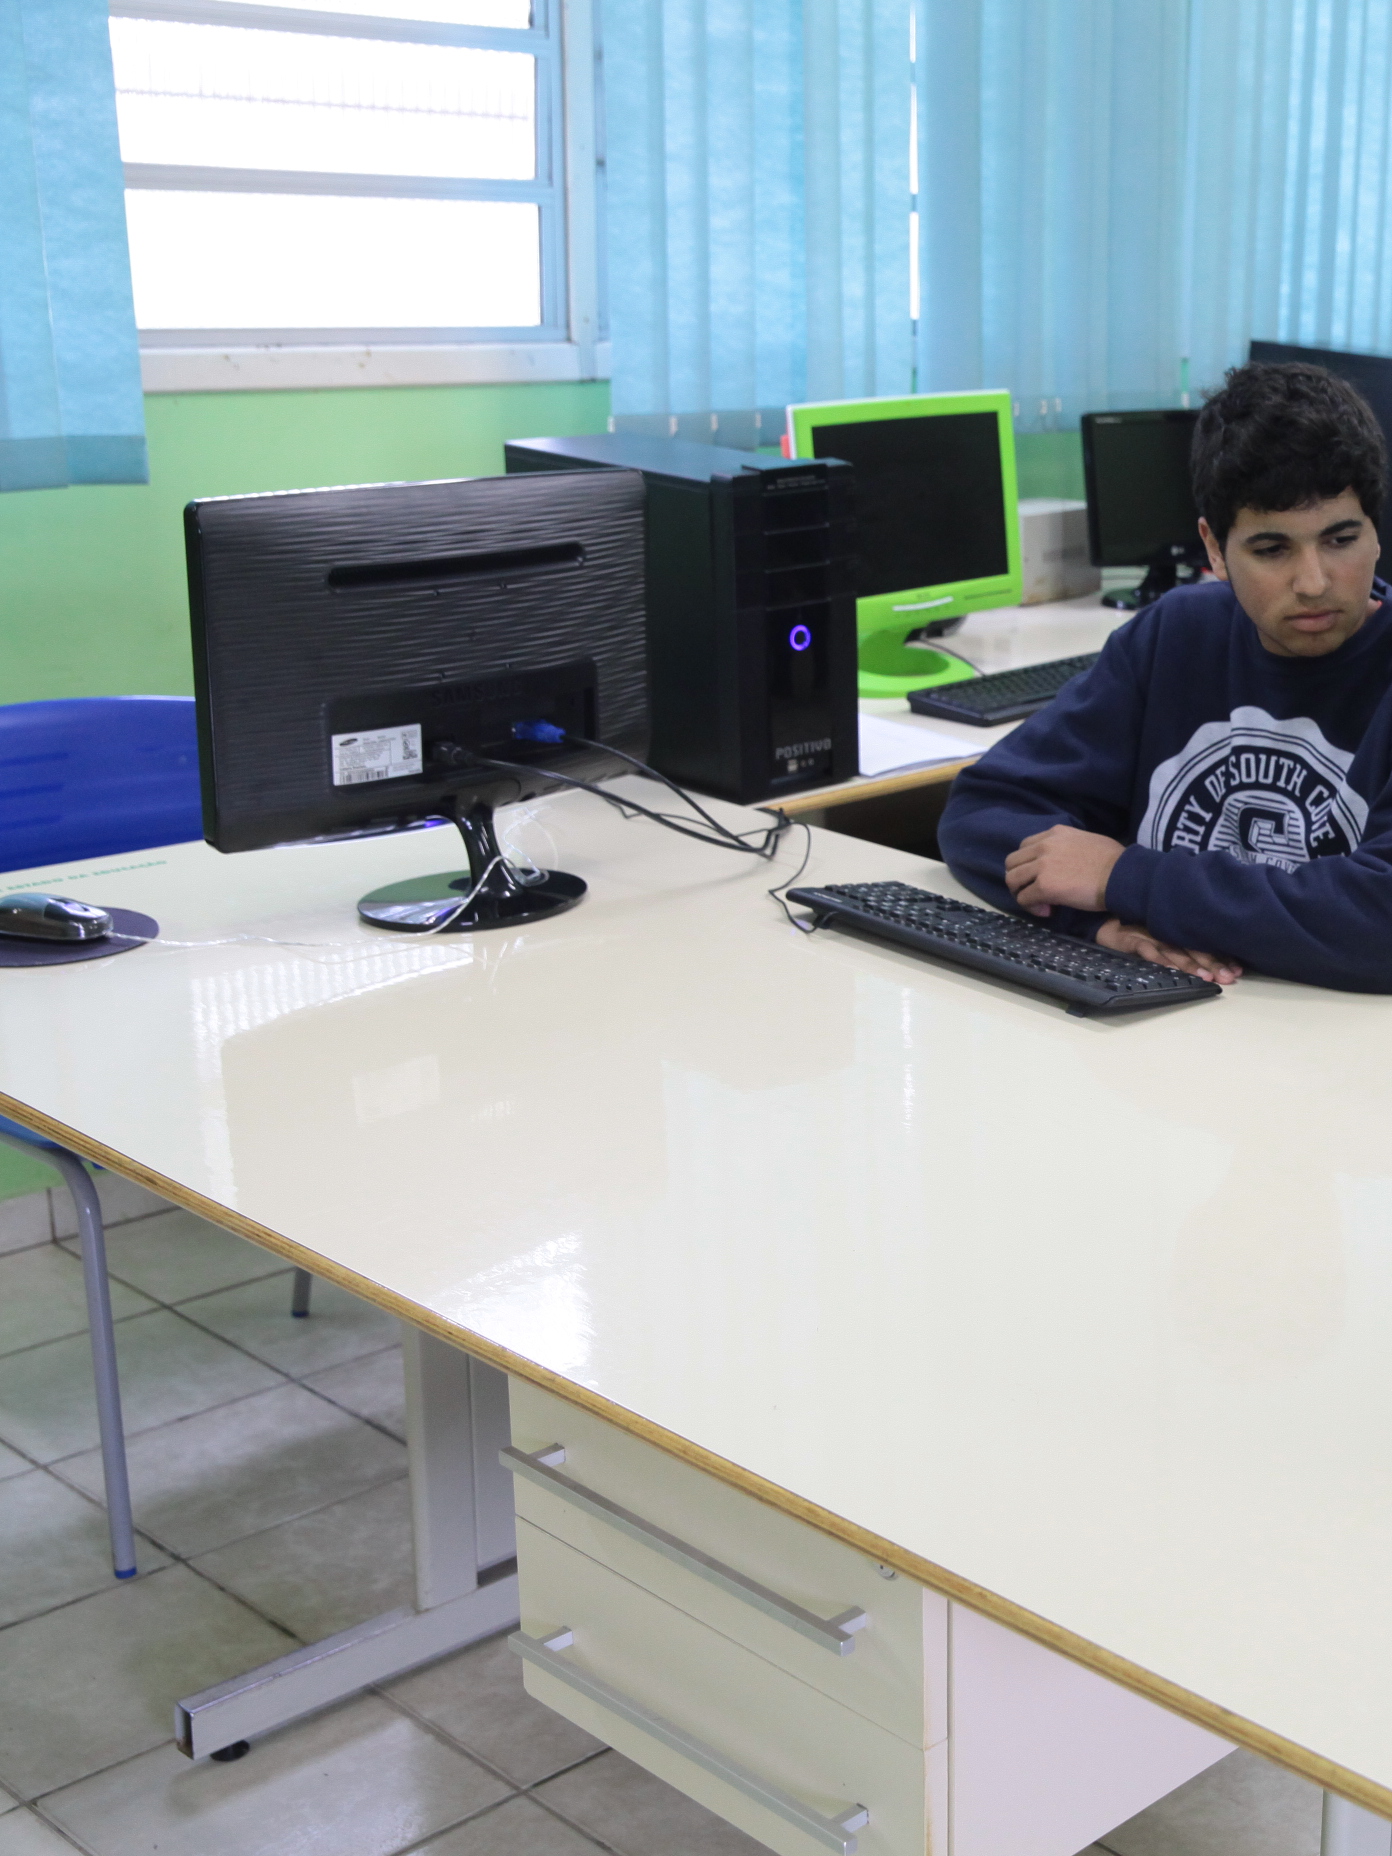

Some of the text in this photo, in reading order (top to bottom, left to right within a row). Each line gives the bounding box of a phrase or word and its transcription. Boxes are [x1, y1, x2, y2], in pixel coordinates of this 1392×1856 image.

[775, 737, 832, 760] POSITIVO
[1204, 765, 1226, 803] OF
[1228, 753, 1307, 797] SOUTH
